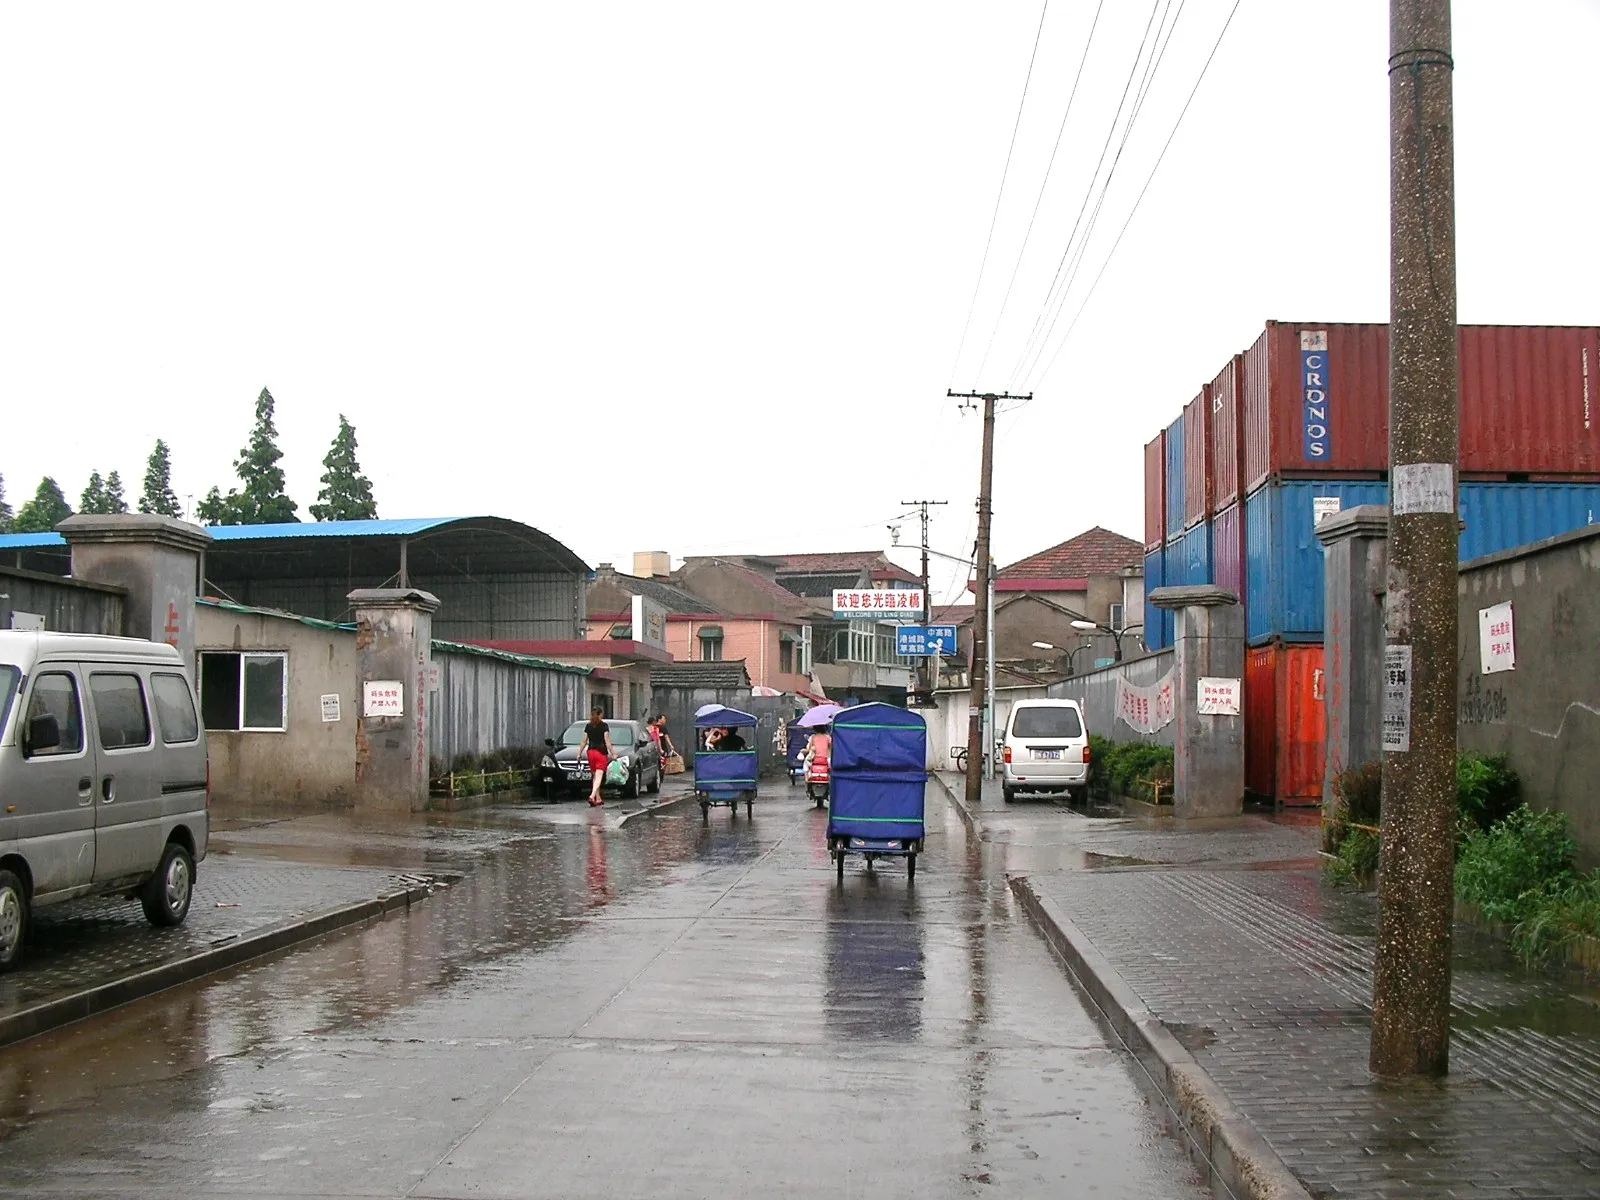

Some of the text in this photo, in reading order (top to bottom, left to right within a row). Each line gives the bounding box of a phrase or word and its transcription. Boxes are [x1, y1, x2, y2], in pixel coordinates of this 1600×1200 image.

[1306, 355, 1326, 457] CRONOS
[837, 593, 920, 608] 歡迎您光臨凌橋
[927, 628, 953, 637] 中高路
[1490, 621, 1510, 637] 码头危险
[1491, 641, 1511, 656] 严禁入内
[371, 690, 398, 698] 码头危险
[1204, 687, 1233, 695] 码头危险
[1204, 697, 1232, 705] 严禁入内
